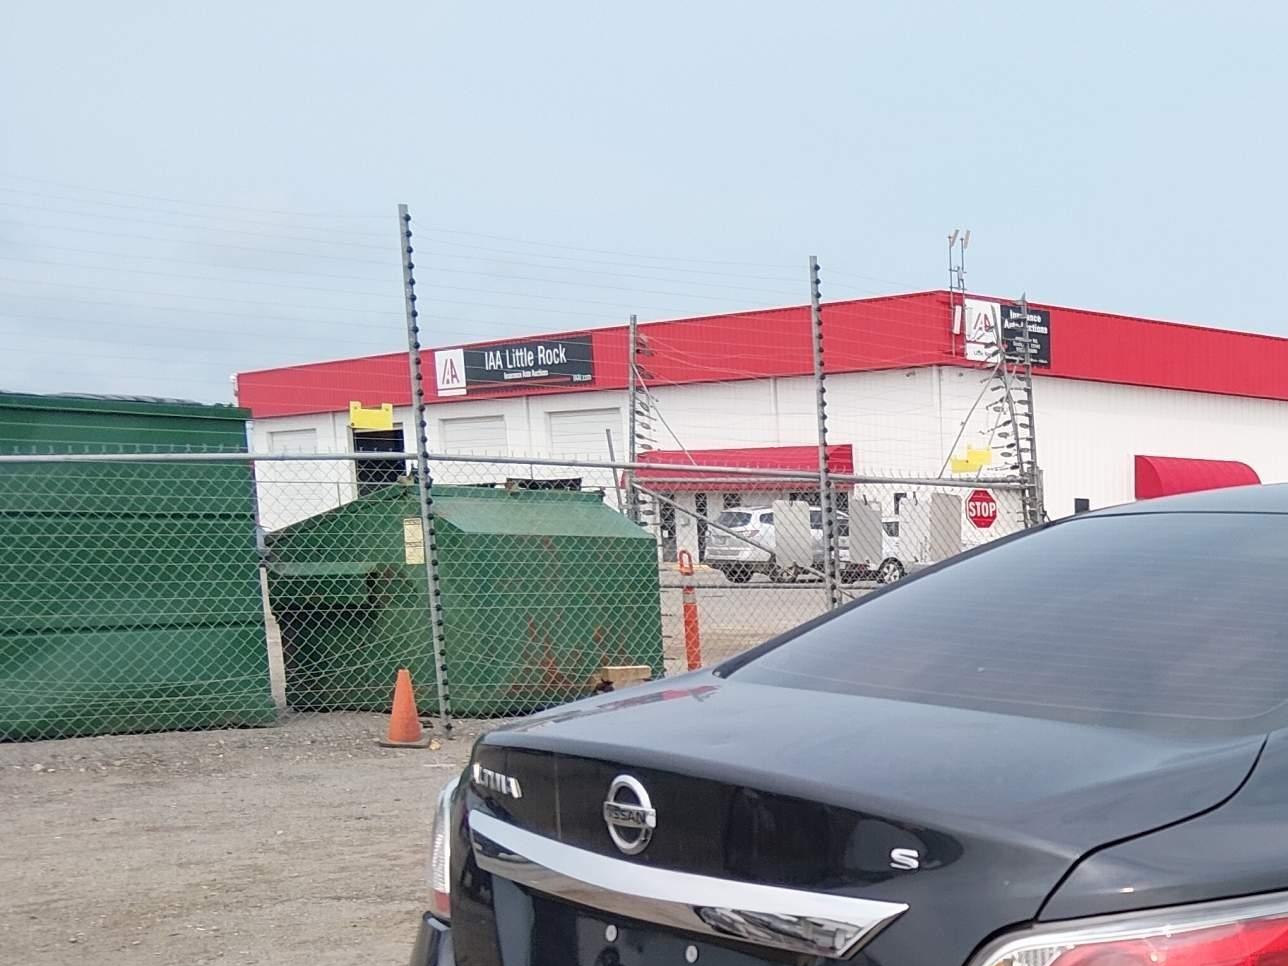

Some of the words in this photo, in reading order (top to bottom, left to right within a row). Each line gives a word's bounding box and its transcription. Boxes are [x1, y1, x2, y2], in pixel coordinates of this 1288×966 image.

[485, 350, 504, 371] IAA
[506, 348, 534, 369] Little
[538, 343, 568, 365] Rock
[969, 501, 996, 517] STOP
[890, 848, 919, 870] S
